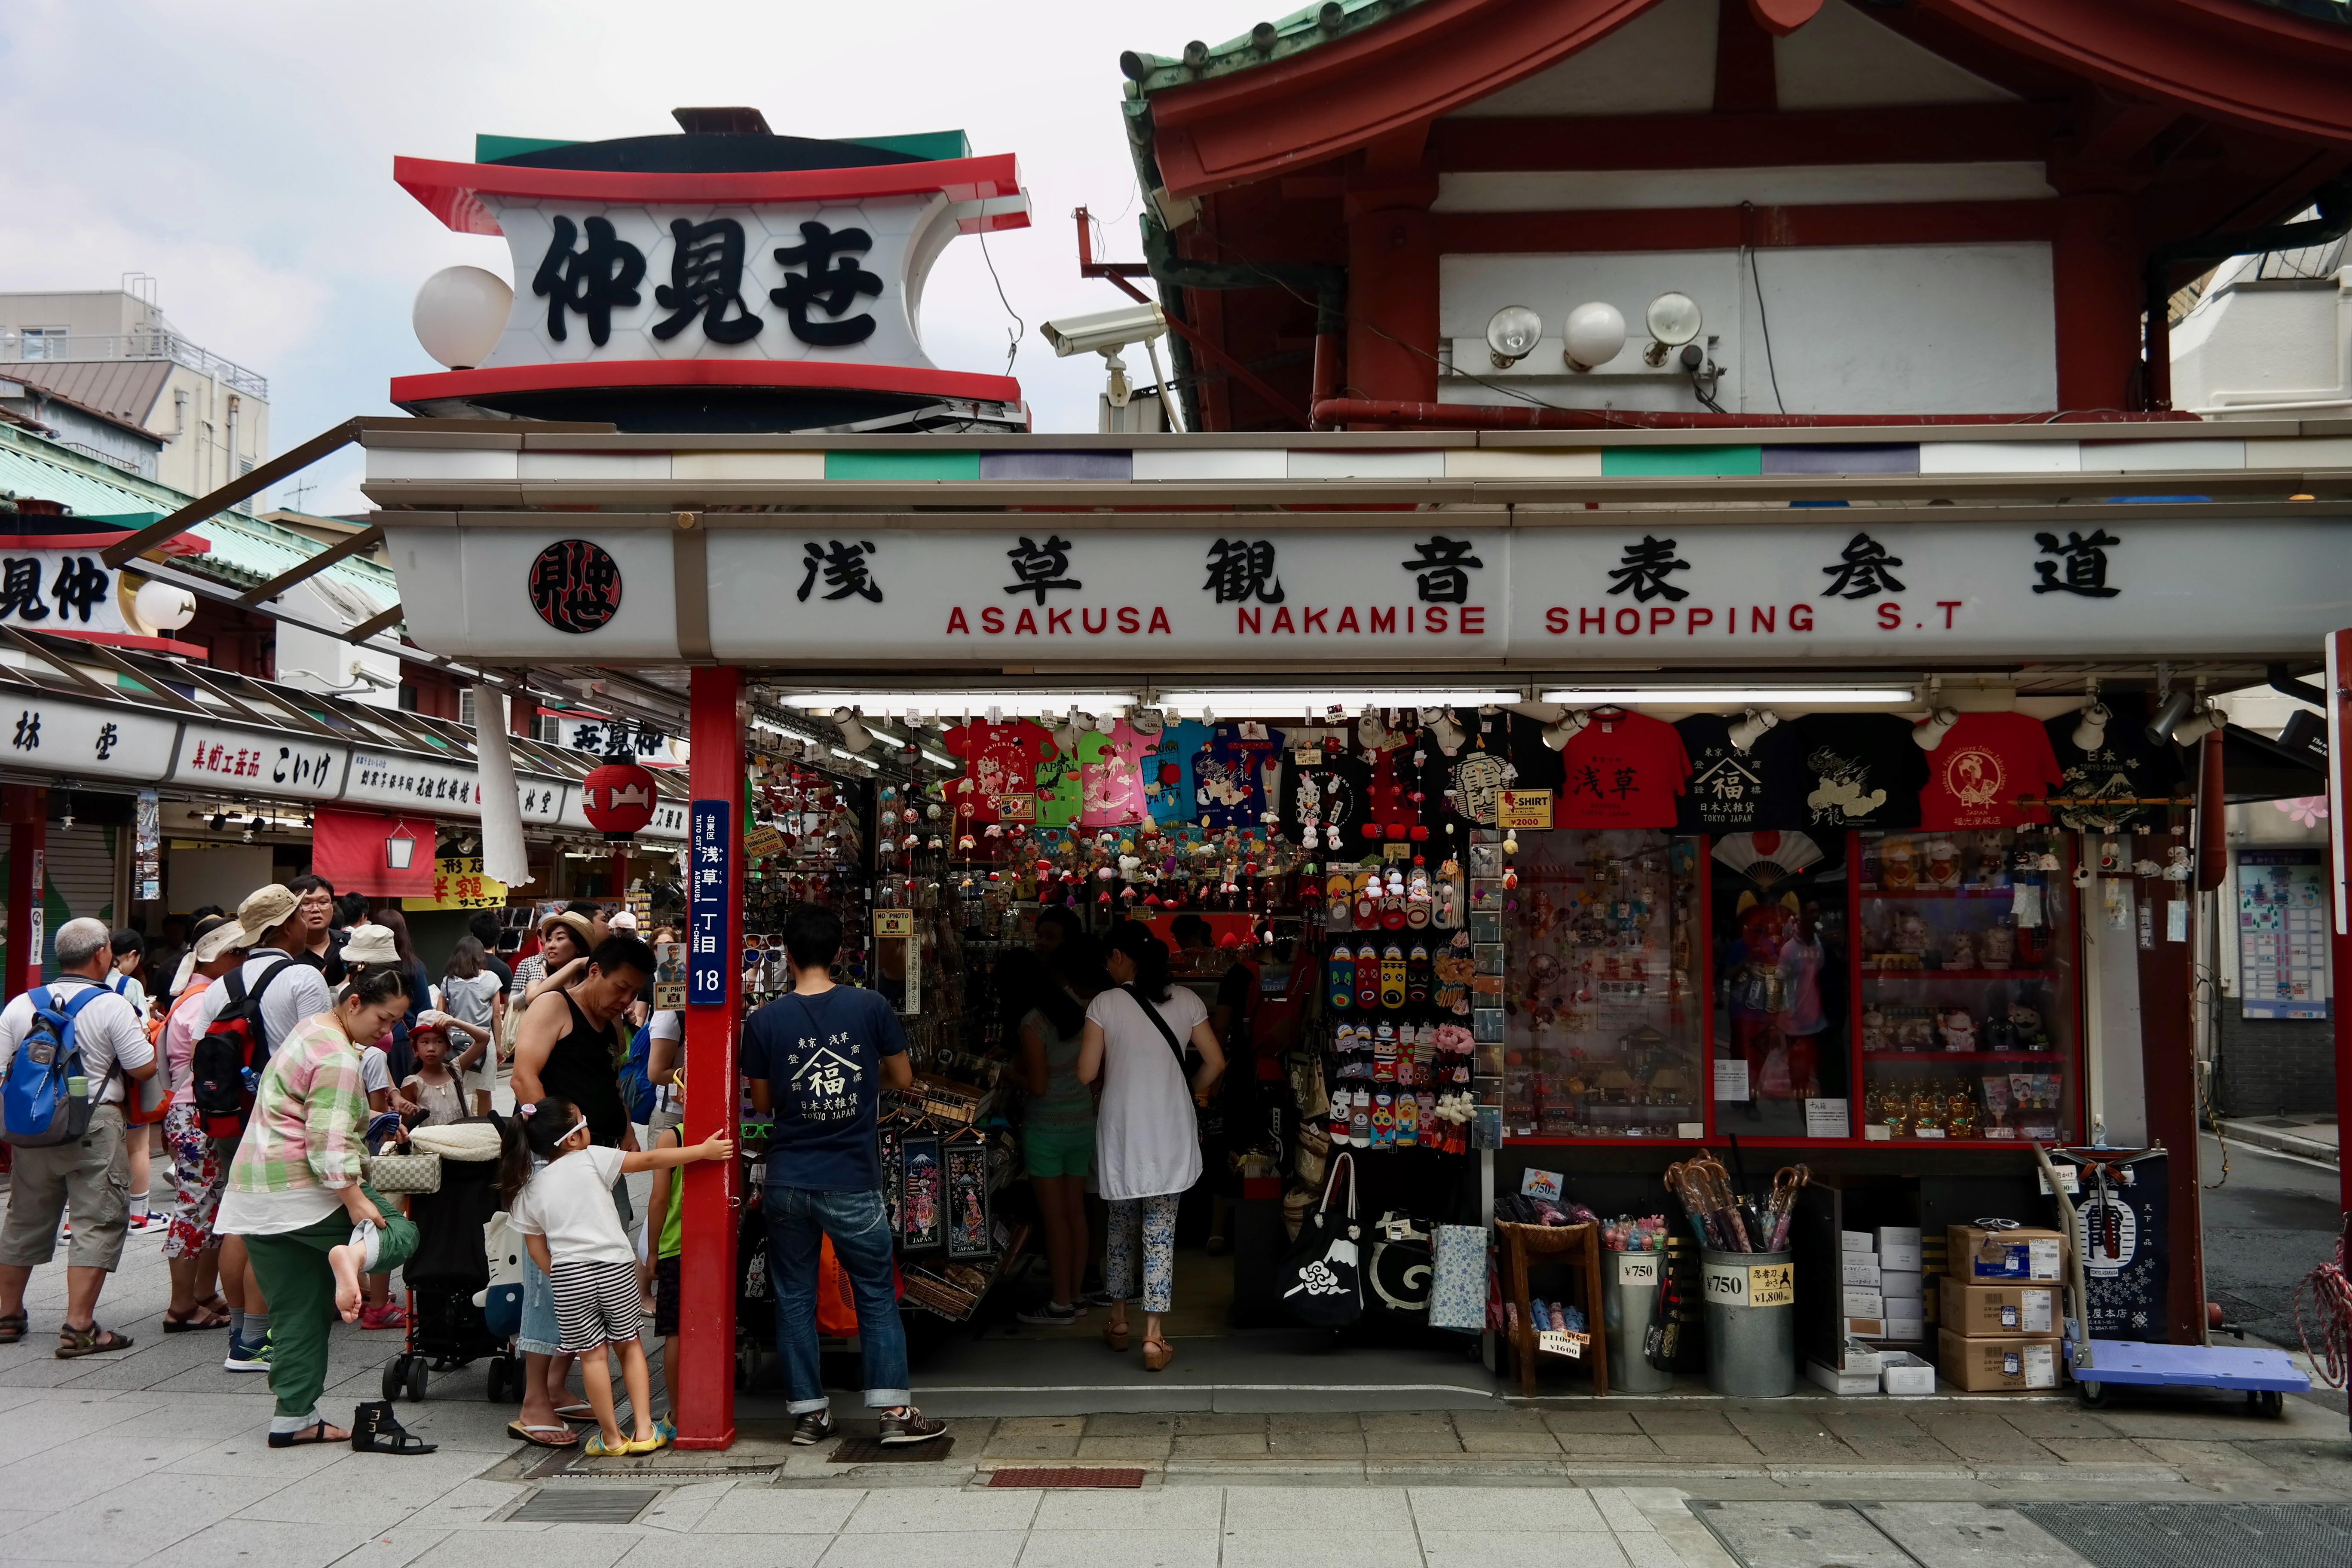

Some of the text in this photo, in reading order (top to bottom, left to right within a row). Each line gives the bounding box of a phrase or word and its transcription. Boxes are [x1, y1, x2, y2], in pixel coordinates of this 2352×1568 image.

[532, 215, 884, 346] 仲見世
[796, 529, 2122, 606] 浅草観音表参道
[946, 600, 1963, 635] ASAKUSA NAKAMISE SHOPPING S.T
[983, 741, 1026, 757] MANEKINEKO
[1705, 748, 1752, 757] 東京 浅草
[2086, 749, 2117, 763] 日本
[193, 739, 331, 790] 美術工芸品 こいけ
[1035, 763, 1075, 774] JAPAN
[1573, 765, 1640, 800] 浅草
[1712, 769, 1744, 800] 福
[1512, 797, 1548, 805] -SHIRT
[1960, 789, 1998, 809] 日本
[1700, 802, 1755, 814] 日本式雑貨
[1703, 814, 1726, 822] TOKYO
[707, 814, 716, 840] 台東区
[747, 833, 778, 848] SUNGLASSE
[750, 831, 770, 840] サングラス
[759, 842, 779, 853] ¥1,000
[701, 845, 718, 954] 浅草一丁目
[695, 969, 719, 991] 18
[797, 1031, 849, 1049] 東京 浅草
[807, 1061, 846, 1097] 福
[801, 1092, 858, 1112] 日本式雑貨
[802, 1106, 856, 1121] TOKYO JAPAN
[957, 1163, 977, 1173] 日本
[1529, 1181, 1551, 1194] ¥750
[2143, 1204, 2153, 1246] 天下一品
[1624, 1264, 1653, 1277] ¥750
[1753, 1269, 1777, 1279] 忍者刀
[1706, 1275, 1742, 1294] ¥750
[1765, 1279, 1778, 1287] かさ
[1754, 1291, 1783, 1304] ¥1,800
[1550, 1344, 1577, 1355] ¥1600
